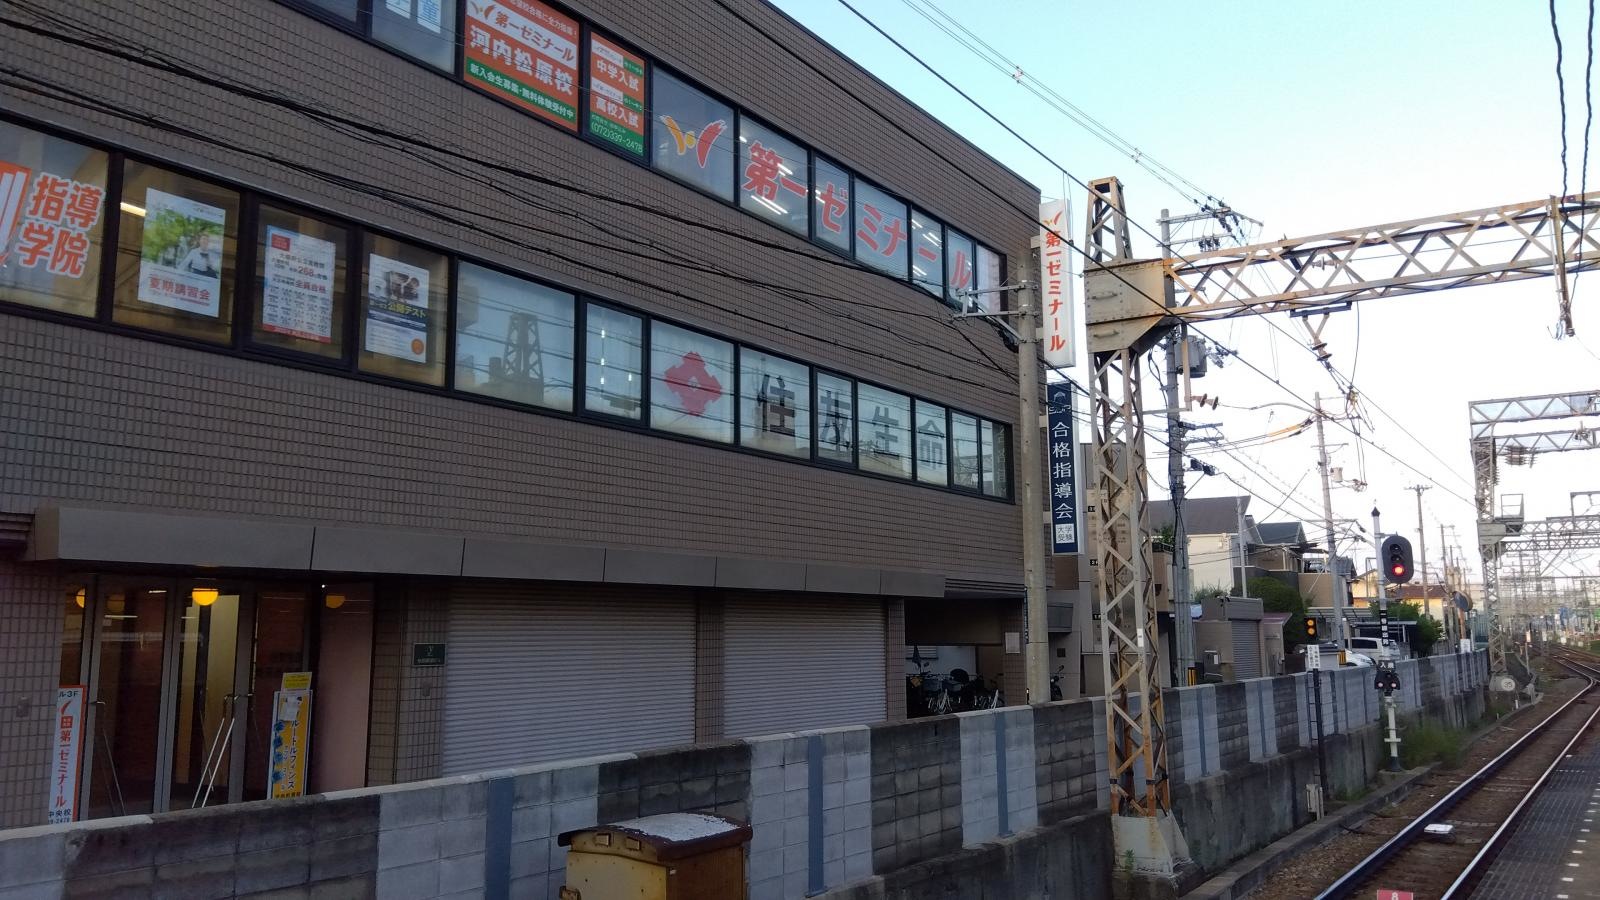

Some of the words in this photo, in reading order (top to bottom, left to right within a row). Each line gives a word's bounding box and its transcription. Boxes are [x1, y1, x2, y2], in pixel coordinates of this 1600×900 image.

[470, 24, 573, 96] 河内松原校
[495, 11, 575, 62] 第一ゼミナール
[596, 59, 639, 92] 中学入試
[596, 96, 639, 129] 高校入試
[27, 173, 104, 229] 指導
[742, 139, 973, 289] 第一ゼミナール
[16, 221, 89, 276] 学院
[1045, 229, 1066, 353] 第一ゼミナール
[757, 374, 946, 471] 住友生命
[1051, 421, 1073, 520] 合格指導会
[1503, 681, 1513, 689] 35
[56, 729, 72, 808] 第一ゼミナール
